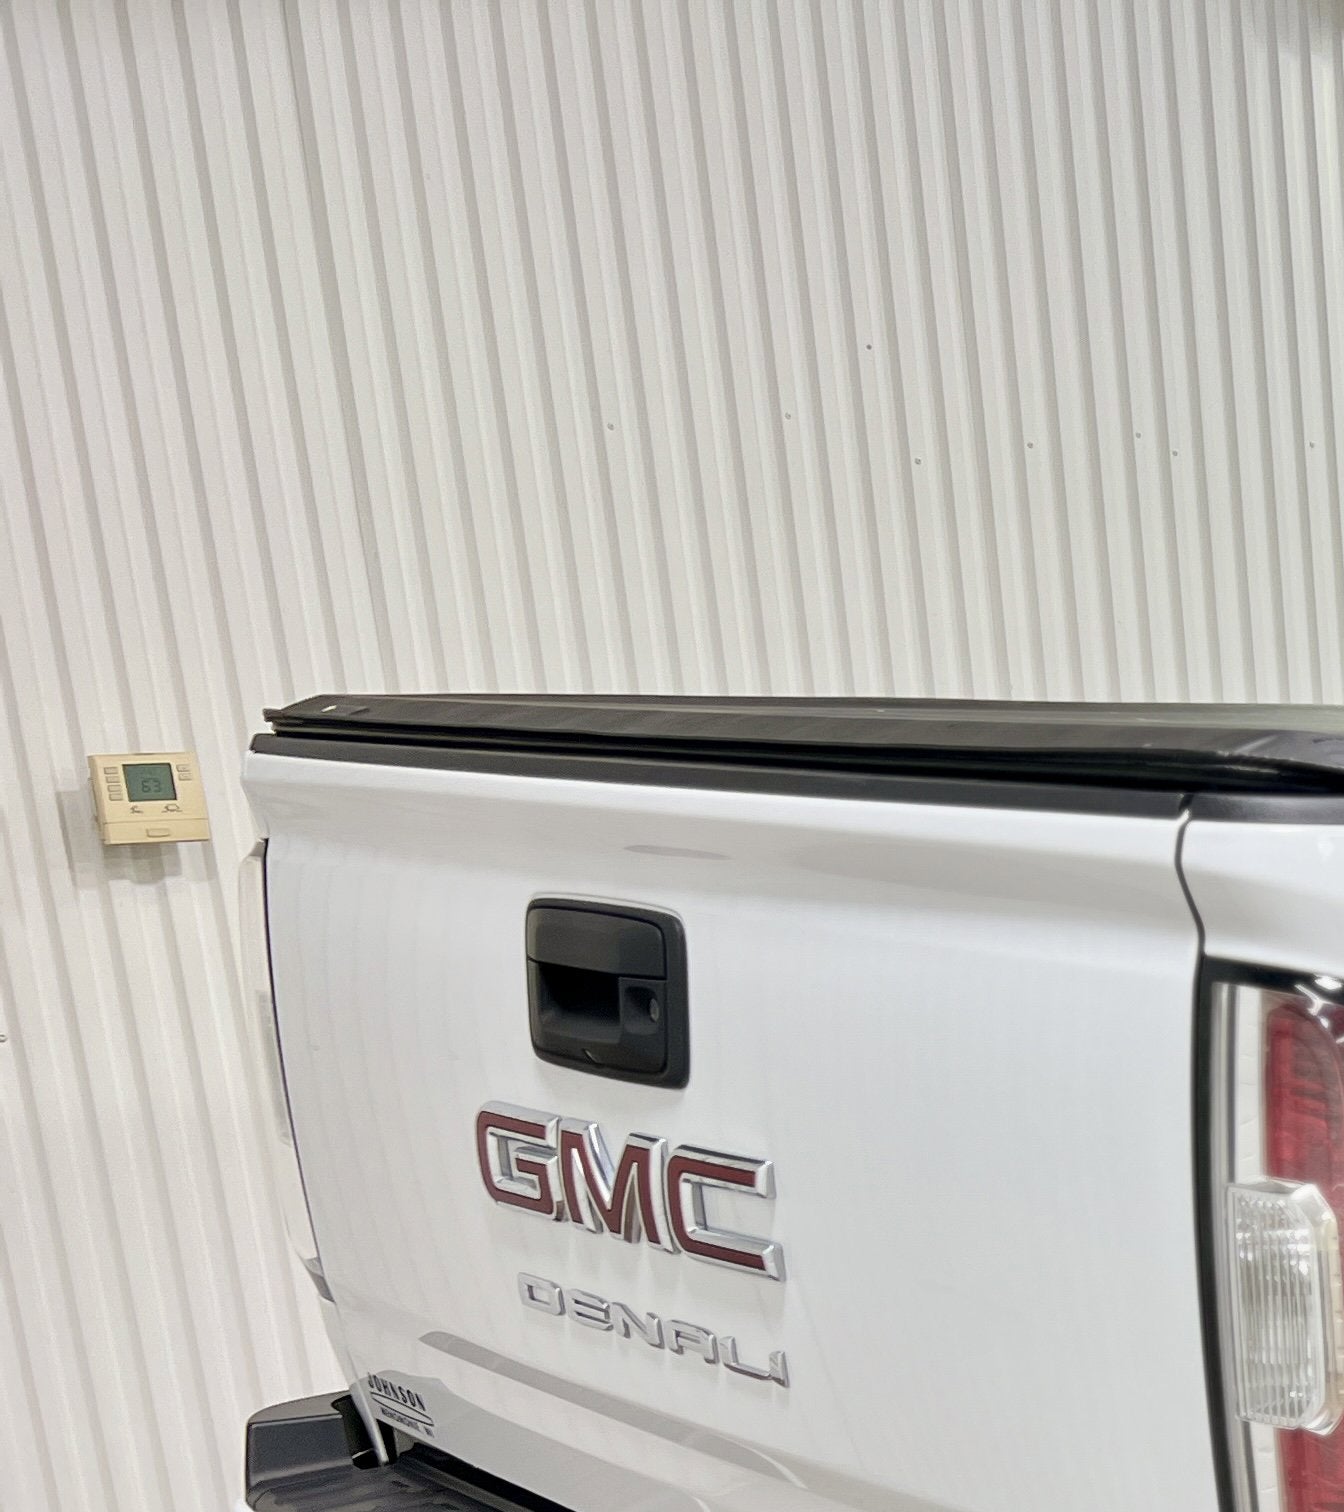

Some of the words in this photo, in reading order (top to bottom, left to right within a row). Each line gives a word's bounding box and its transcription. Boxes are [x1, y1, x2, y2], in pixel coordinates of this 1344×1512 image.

[141, 779, 162, 793] 63
[476, 1100, 786, 1282] GMC
[517, 1272, 790, 1388] DENALI
[367, 1372, 426, 1412] JOHNSON
